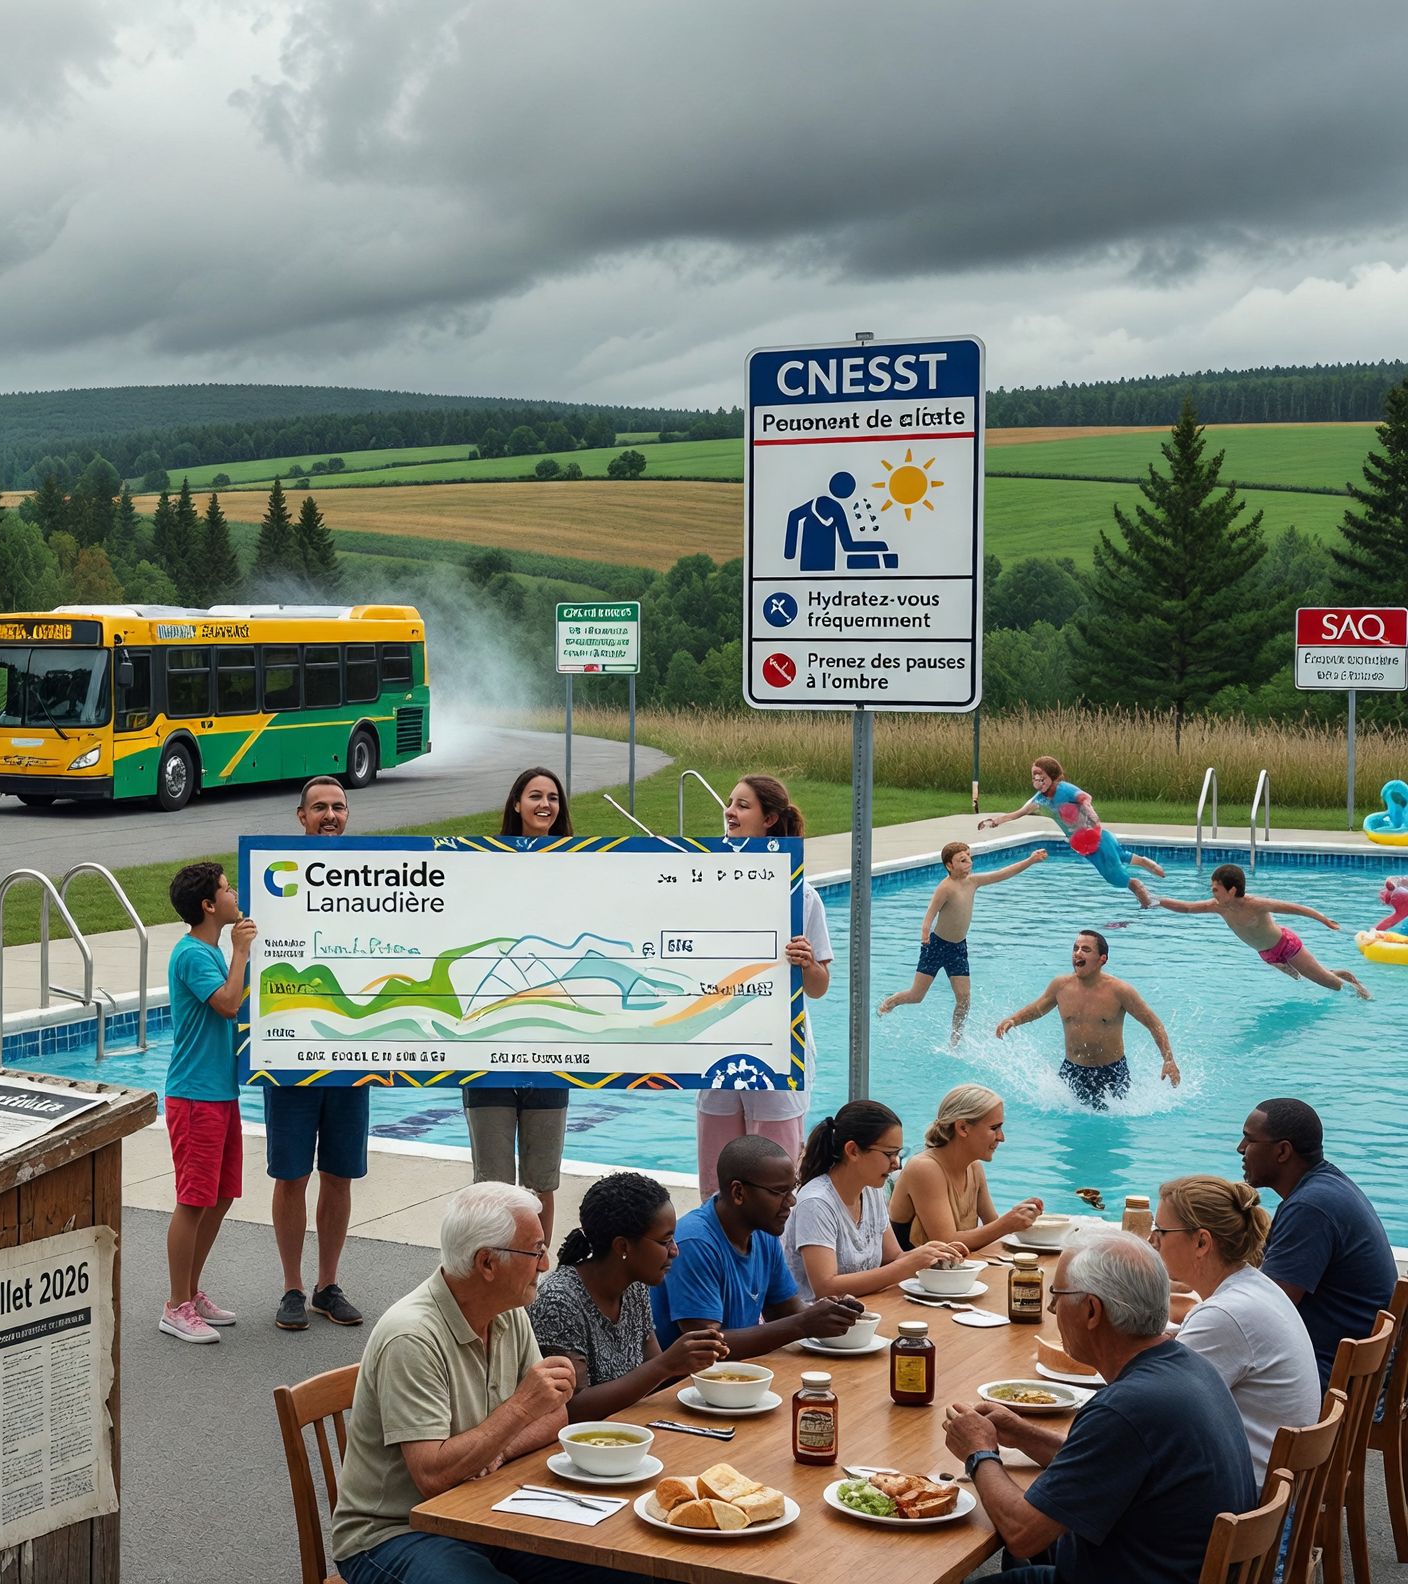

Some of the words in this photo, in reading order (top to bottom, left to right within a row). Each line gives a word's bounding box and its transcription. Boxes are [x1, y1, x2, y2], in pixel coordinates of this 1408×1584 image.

[776, 352, 948, 397] CNESST
[866, 409, 892, 429] de
[808, 590, 940, 611] Hydratez-vous
[1321, 613, 1391, 644] SAQ
[807, 652, 866, 668] Prenez
[870, 652, 901, 669] des
[906, 656, 966, 672] pauses
[806, 673, 816, 689] à
[822, 672, 889, 689] l'ombre
[305, 861, 445, 887] Centraide
[307, 891, 445, 913] Lanaudière
[39, 1261, 89, 1305] 2026
